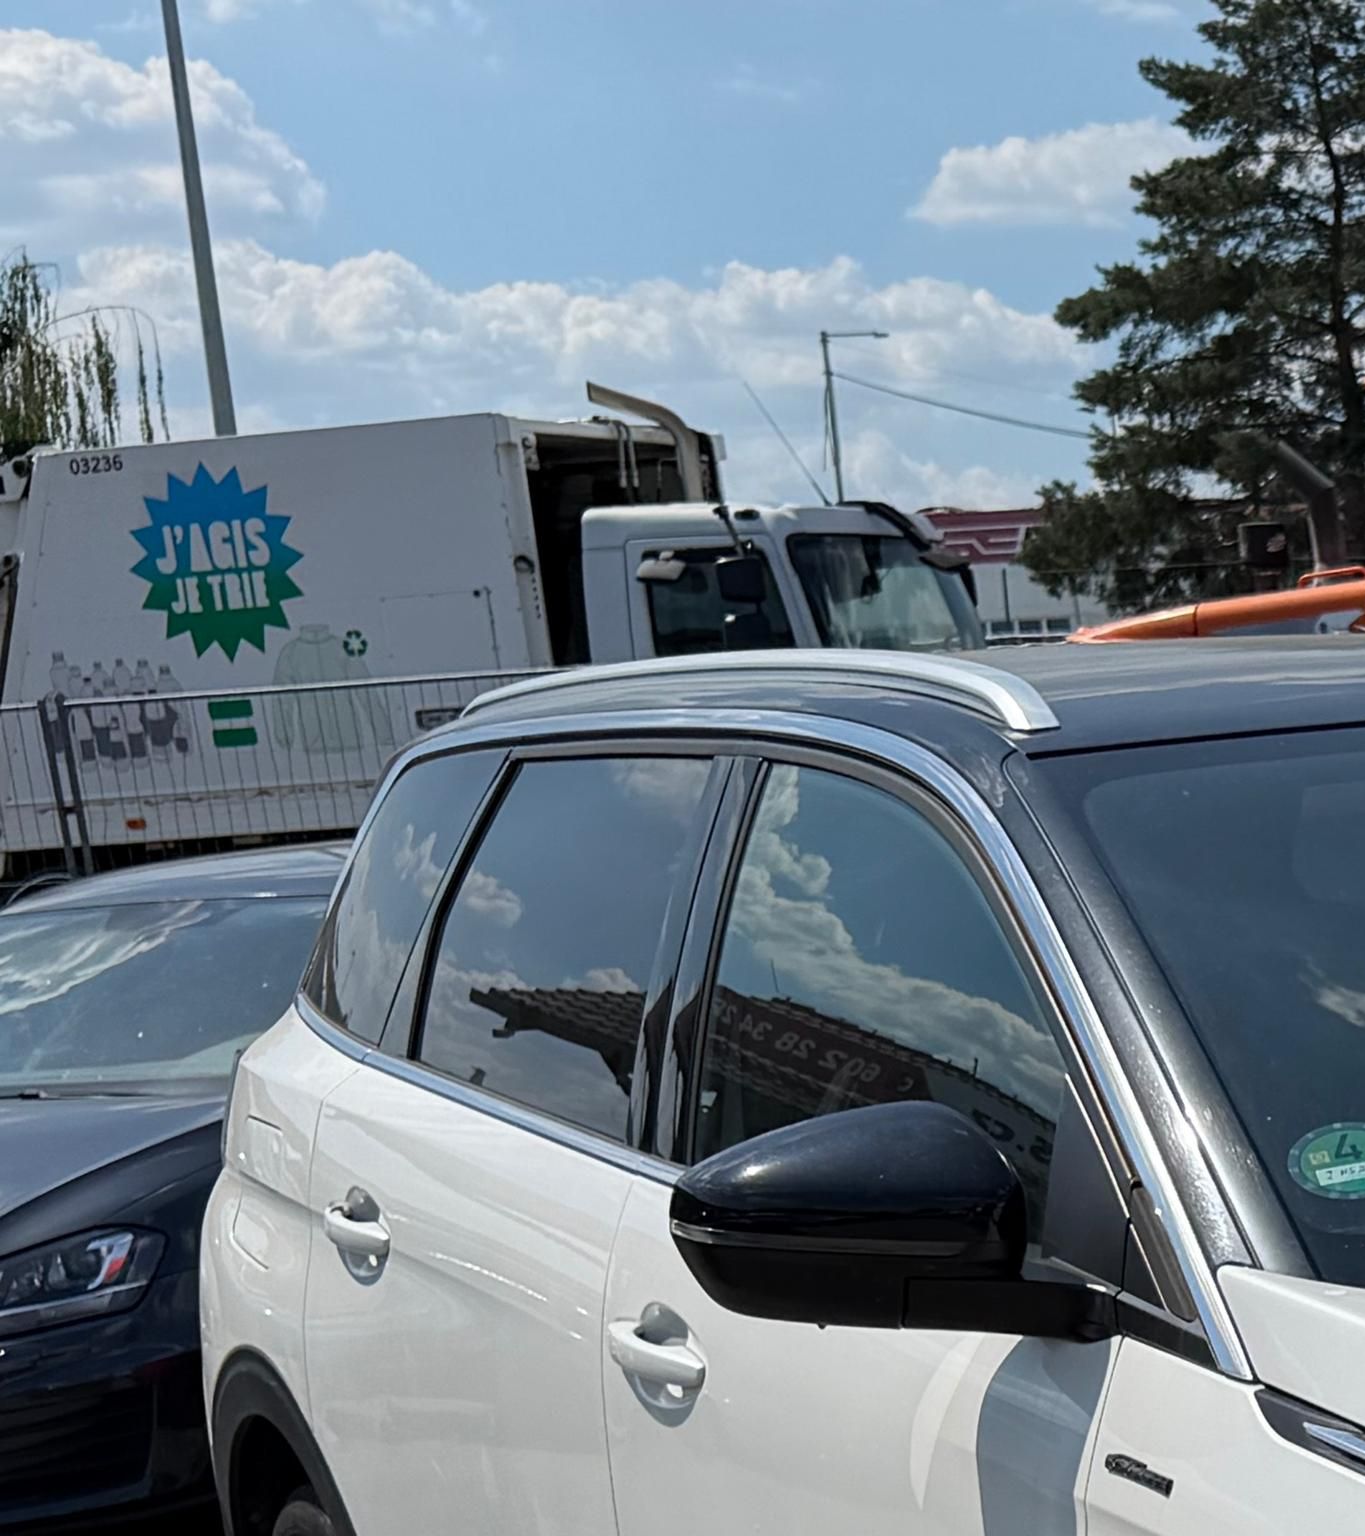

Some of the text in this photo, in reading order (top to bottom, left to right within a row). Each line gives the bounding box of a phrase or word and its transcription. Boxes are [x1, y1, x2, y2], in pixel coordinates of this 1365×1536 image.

[69, 455, 124, 475] 03236
[155, 518, 271, 574] J'AGIS
[171, 571, 271, 614] JE TRIE
[1334, 1133, 1363, 1160] 4
